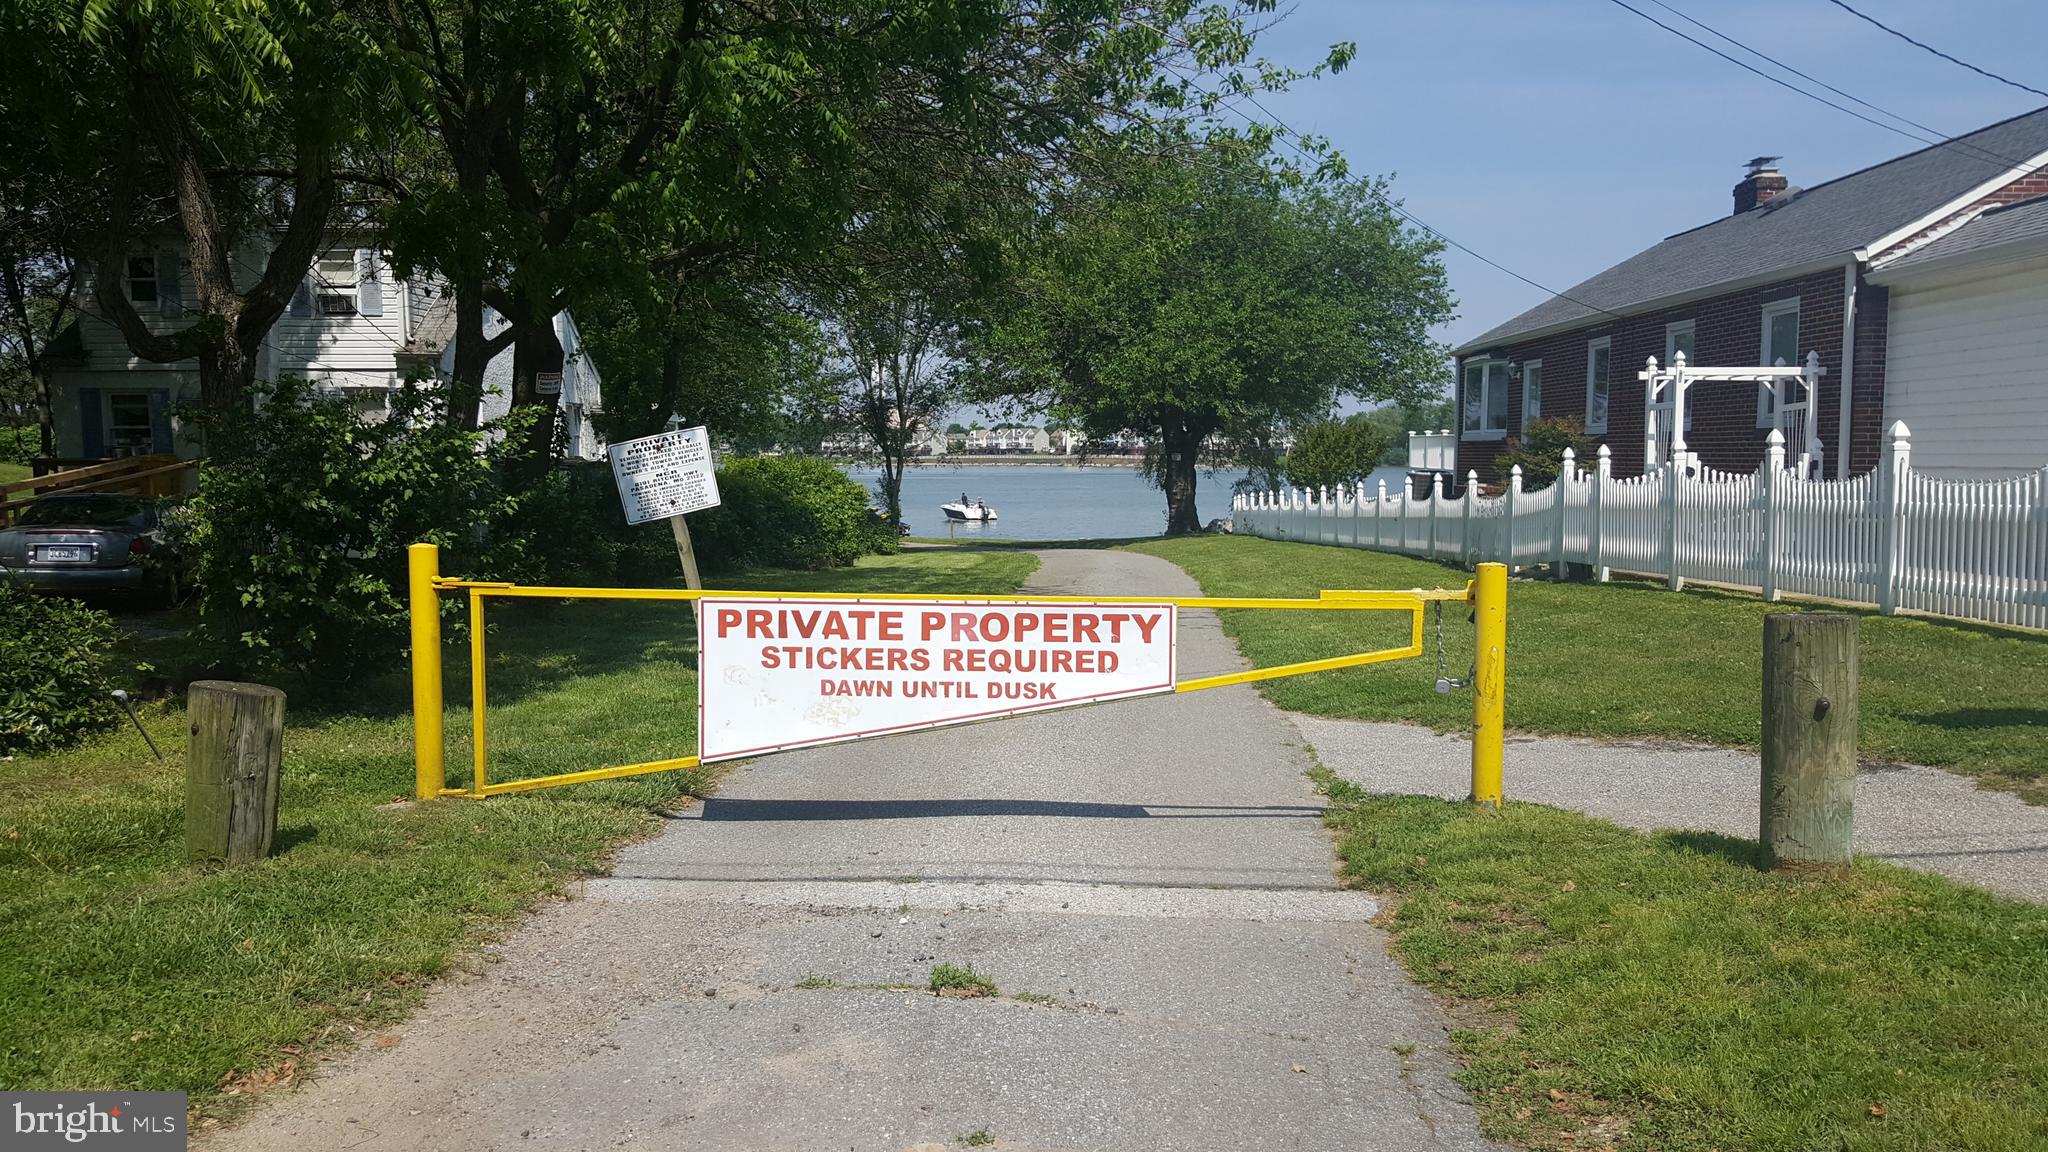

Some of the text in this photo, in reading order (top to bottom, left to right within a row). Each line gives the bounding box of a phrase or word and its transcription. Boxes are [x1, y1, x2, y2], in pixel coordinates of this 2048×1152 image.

[627, 437, 691, 455] PROPERTY
[632, 434, 681, 448] PRIVATE
[677, 446, 703, 454] VEHICLES
[619, 442, 701, 462] VEHICLES PARKED ILLEGALLY
[621, 468, 648, 476] OWNER'S
[681, 456, 704, 464] EXPENSE
[652, 474, 679, 482] RITCHIE
[717, 609, 1162, 644] PRIVATE PROPERTY
[761, 646, 1119, 674] STICKERS REQUIRED
[820, 680, 1056, 700] DAWN UNTIL DUSK
